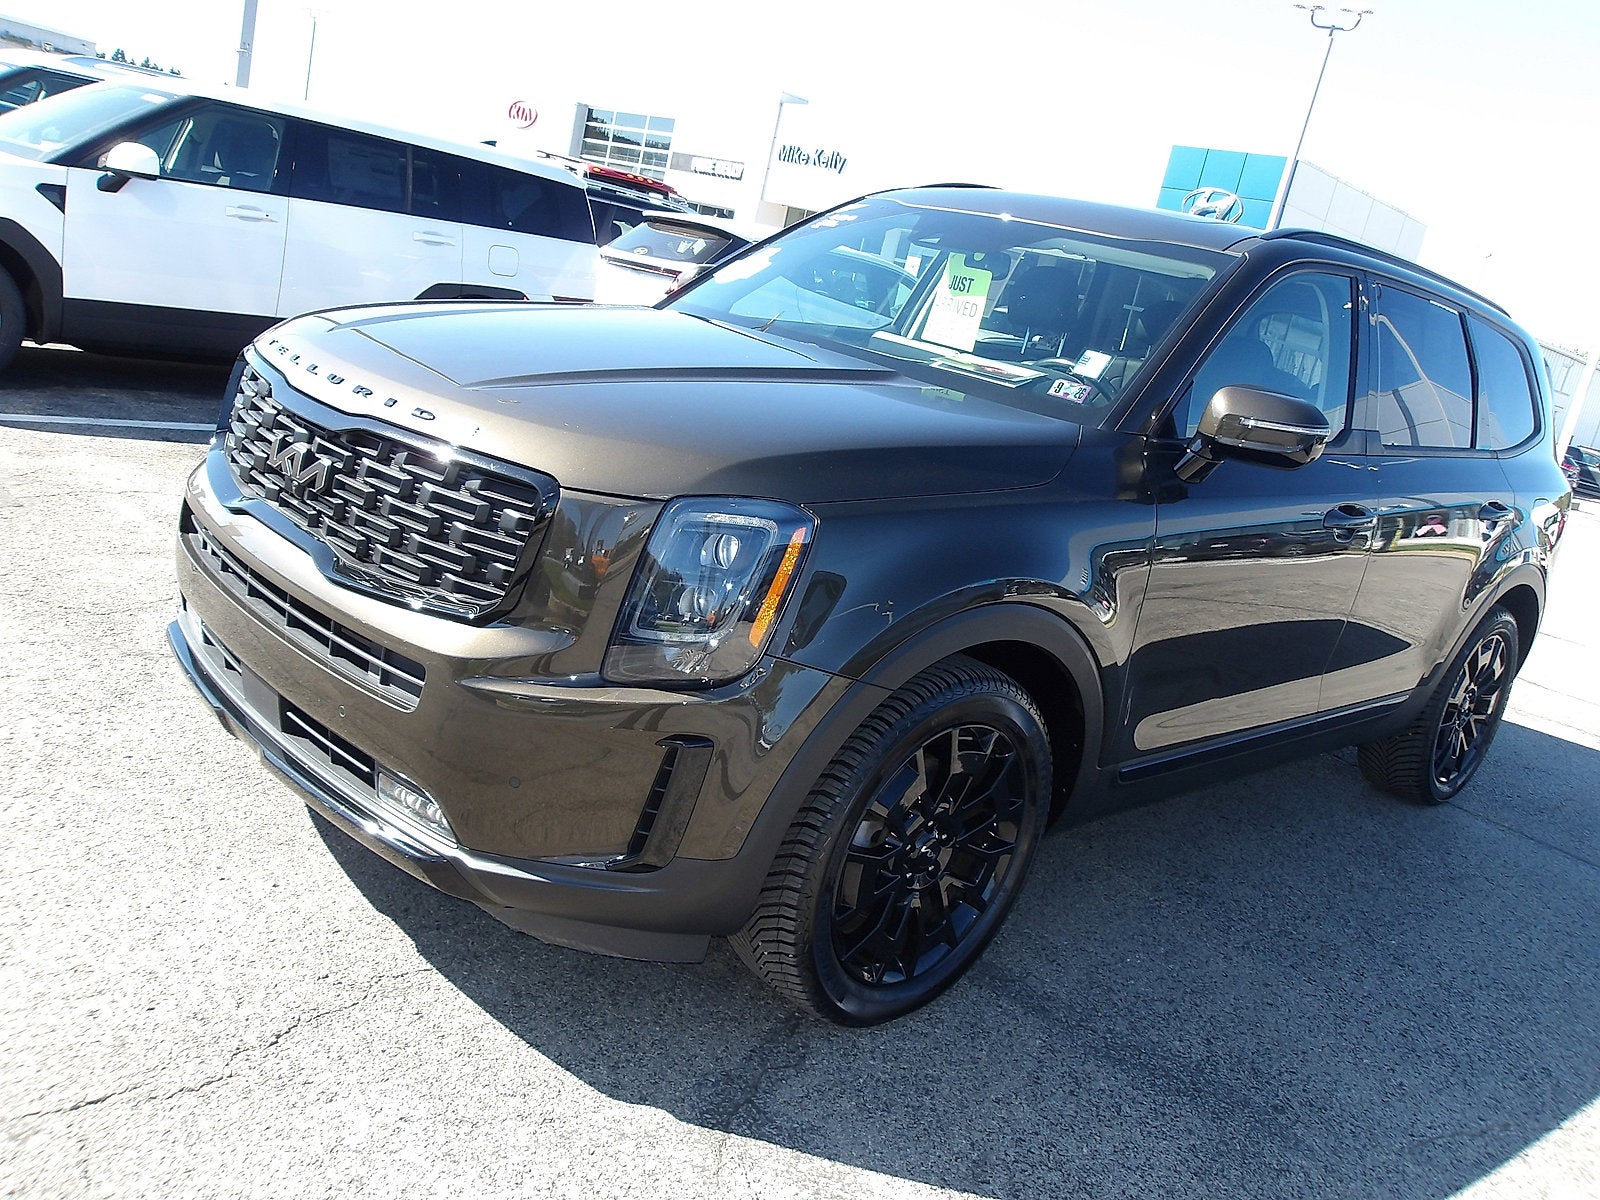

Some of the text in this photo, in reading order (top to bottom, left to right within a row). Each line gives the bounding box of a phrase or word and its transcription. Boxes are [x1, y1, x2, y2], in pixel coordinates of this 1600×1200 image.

[510, 102, 534, 124] KIA
[778, 144, 847, 174] Mike Kelly
[948, 274, 975, 294] JUST
[934, 295, 978, 318] RIVED
[268, 338, 480, 437] TELLURID
[1054, 381, 1064, 394] 9
